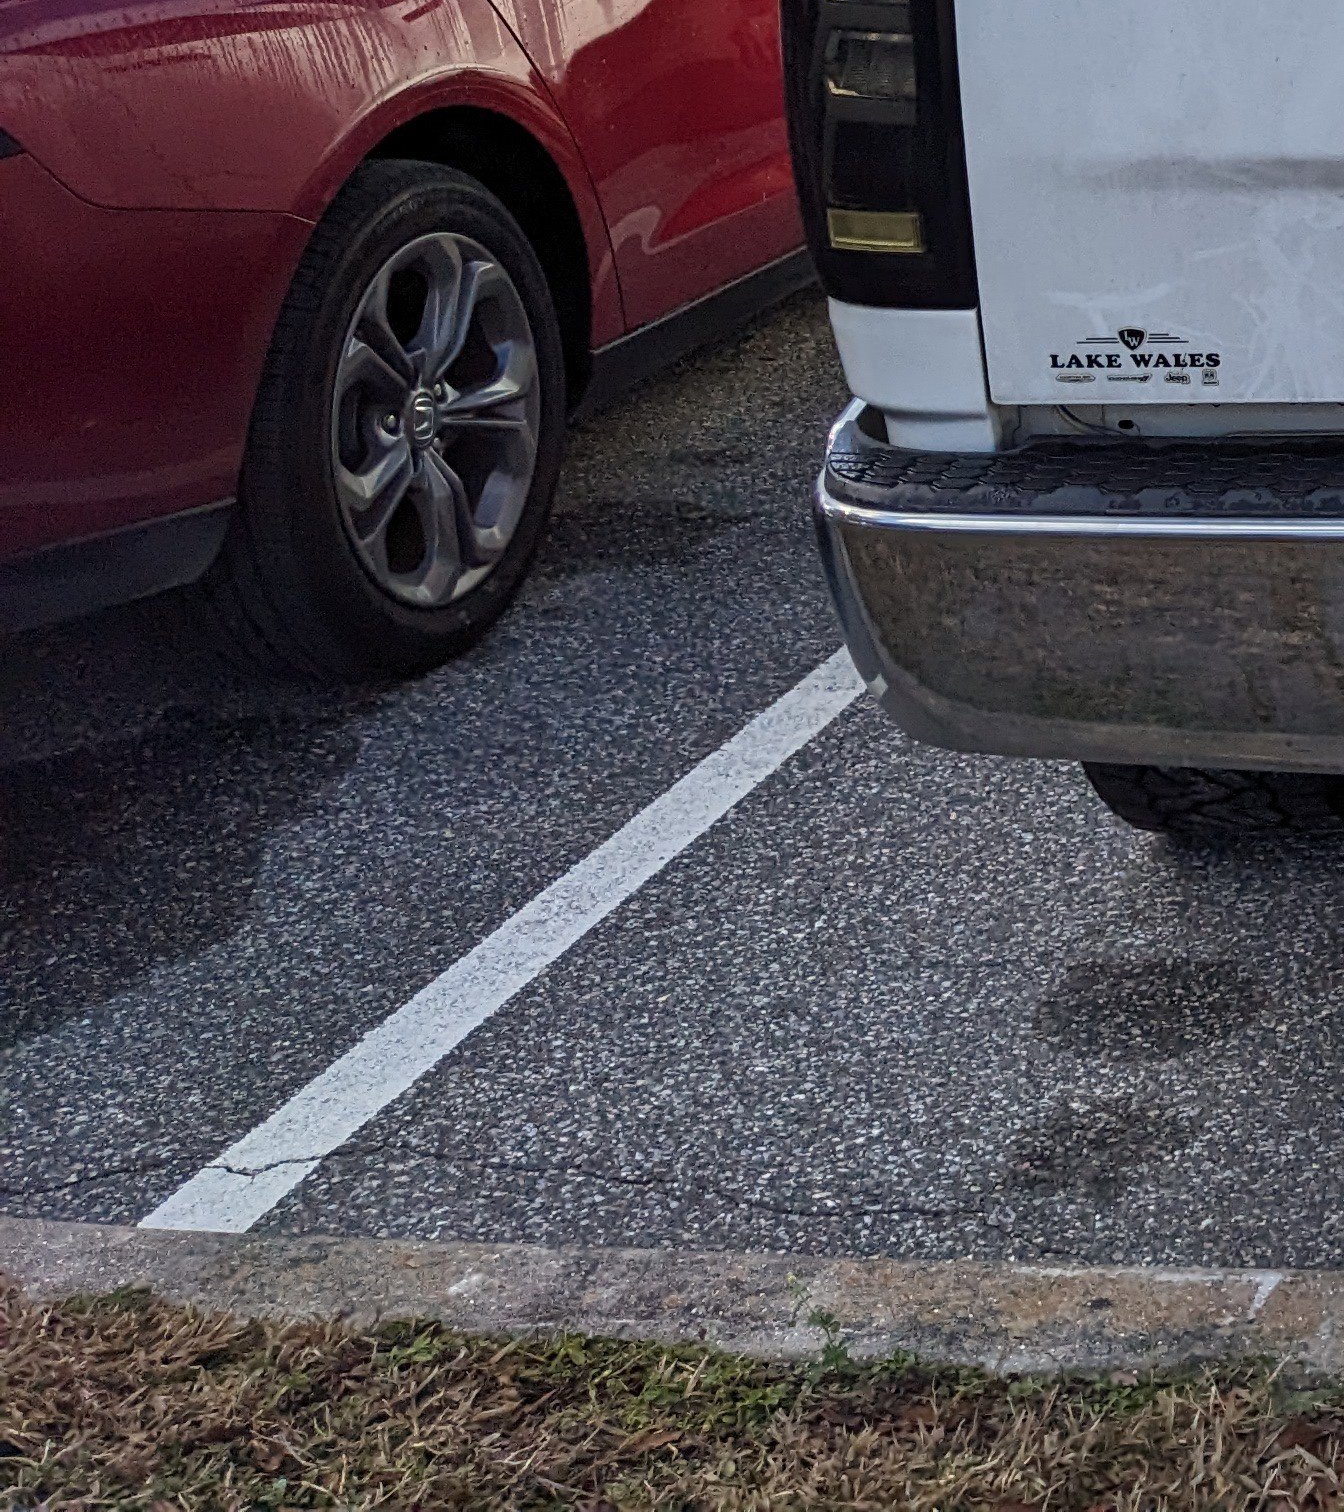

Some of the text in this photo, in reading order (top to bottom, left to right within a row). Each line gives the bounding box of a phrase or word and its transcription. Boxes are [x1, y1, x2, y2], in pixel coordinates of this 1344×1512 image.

[1050, 353, 1221, 368] LAKE WALES
[1165, 373, 1188, 384] Jeep
